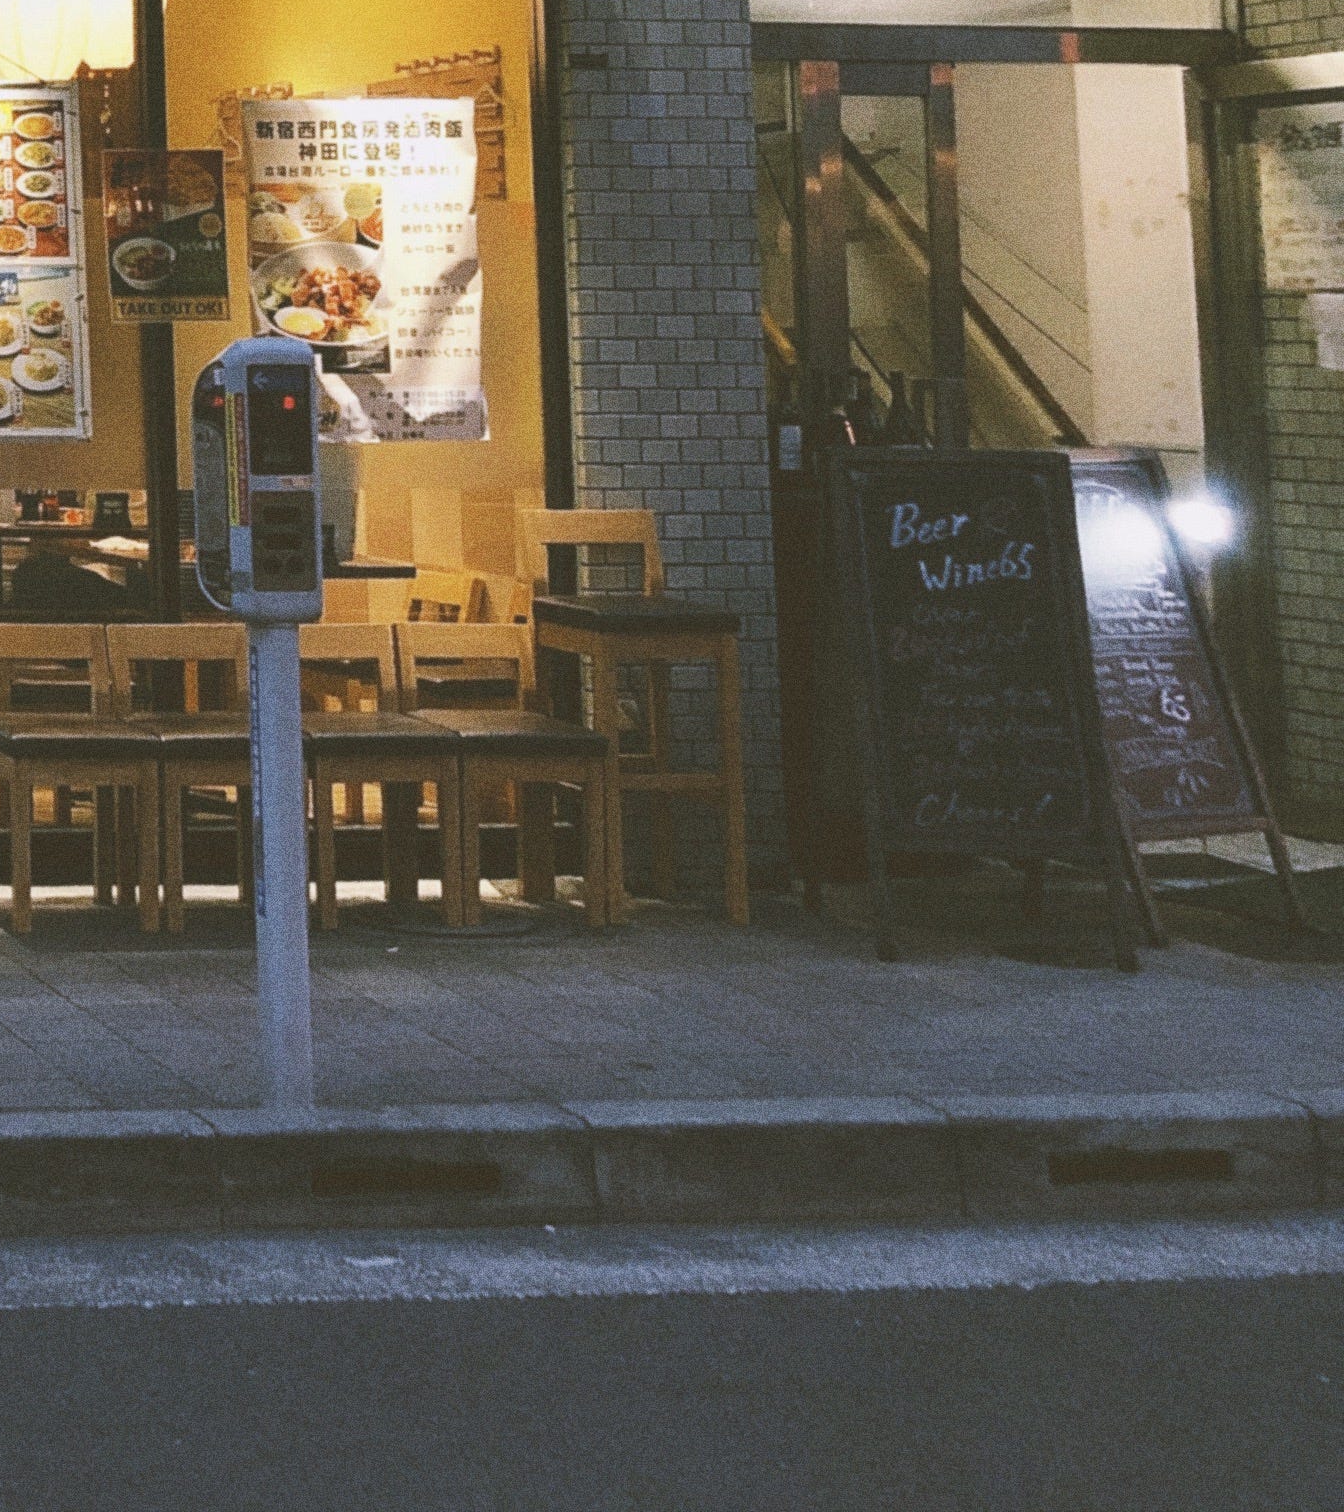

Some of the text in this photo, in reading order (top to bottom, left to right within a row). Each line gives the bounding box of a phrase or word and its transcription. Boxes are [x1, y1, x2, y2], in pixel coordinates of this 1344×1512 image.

[118, 301, 158, 316] TAKE
[161, 301, 192, 316] OUT
[886, 502, 971, 549] Beer
